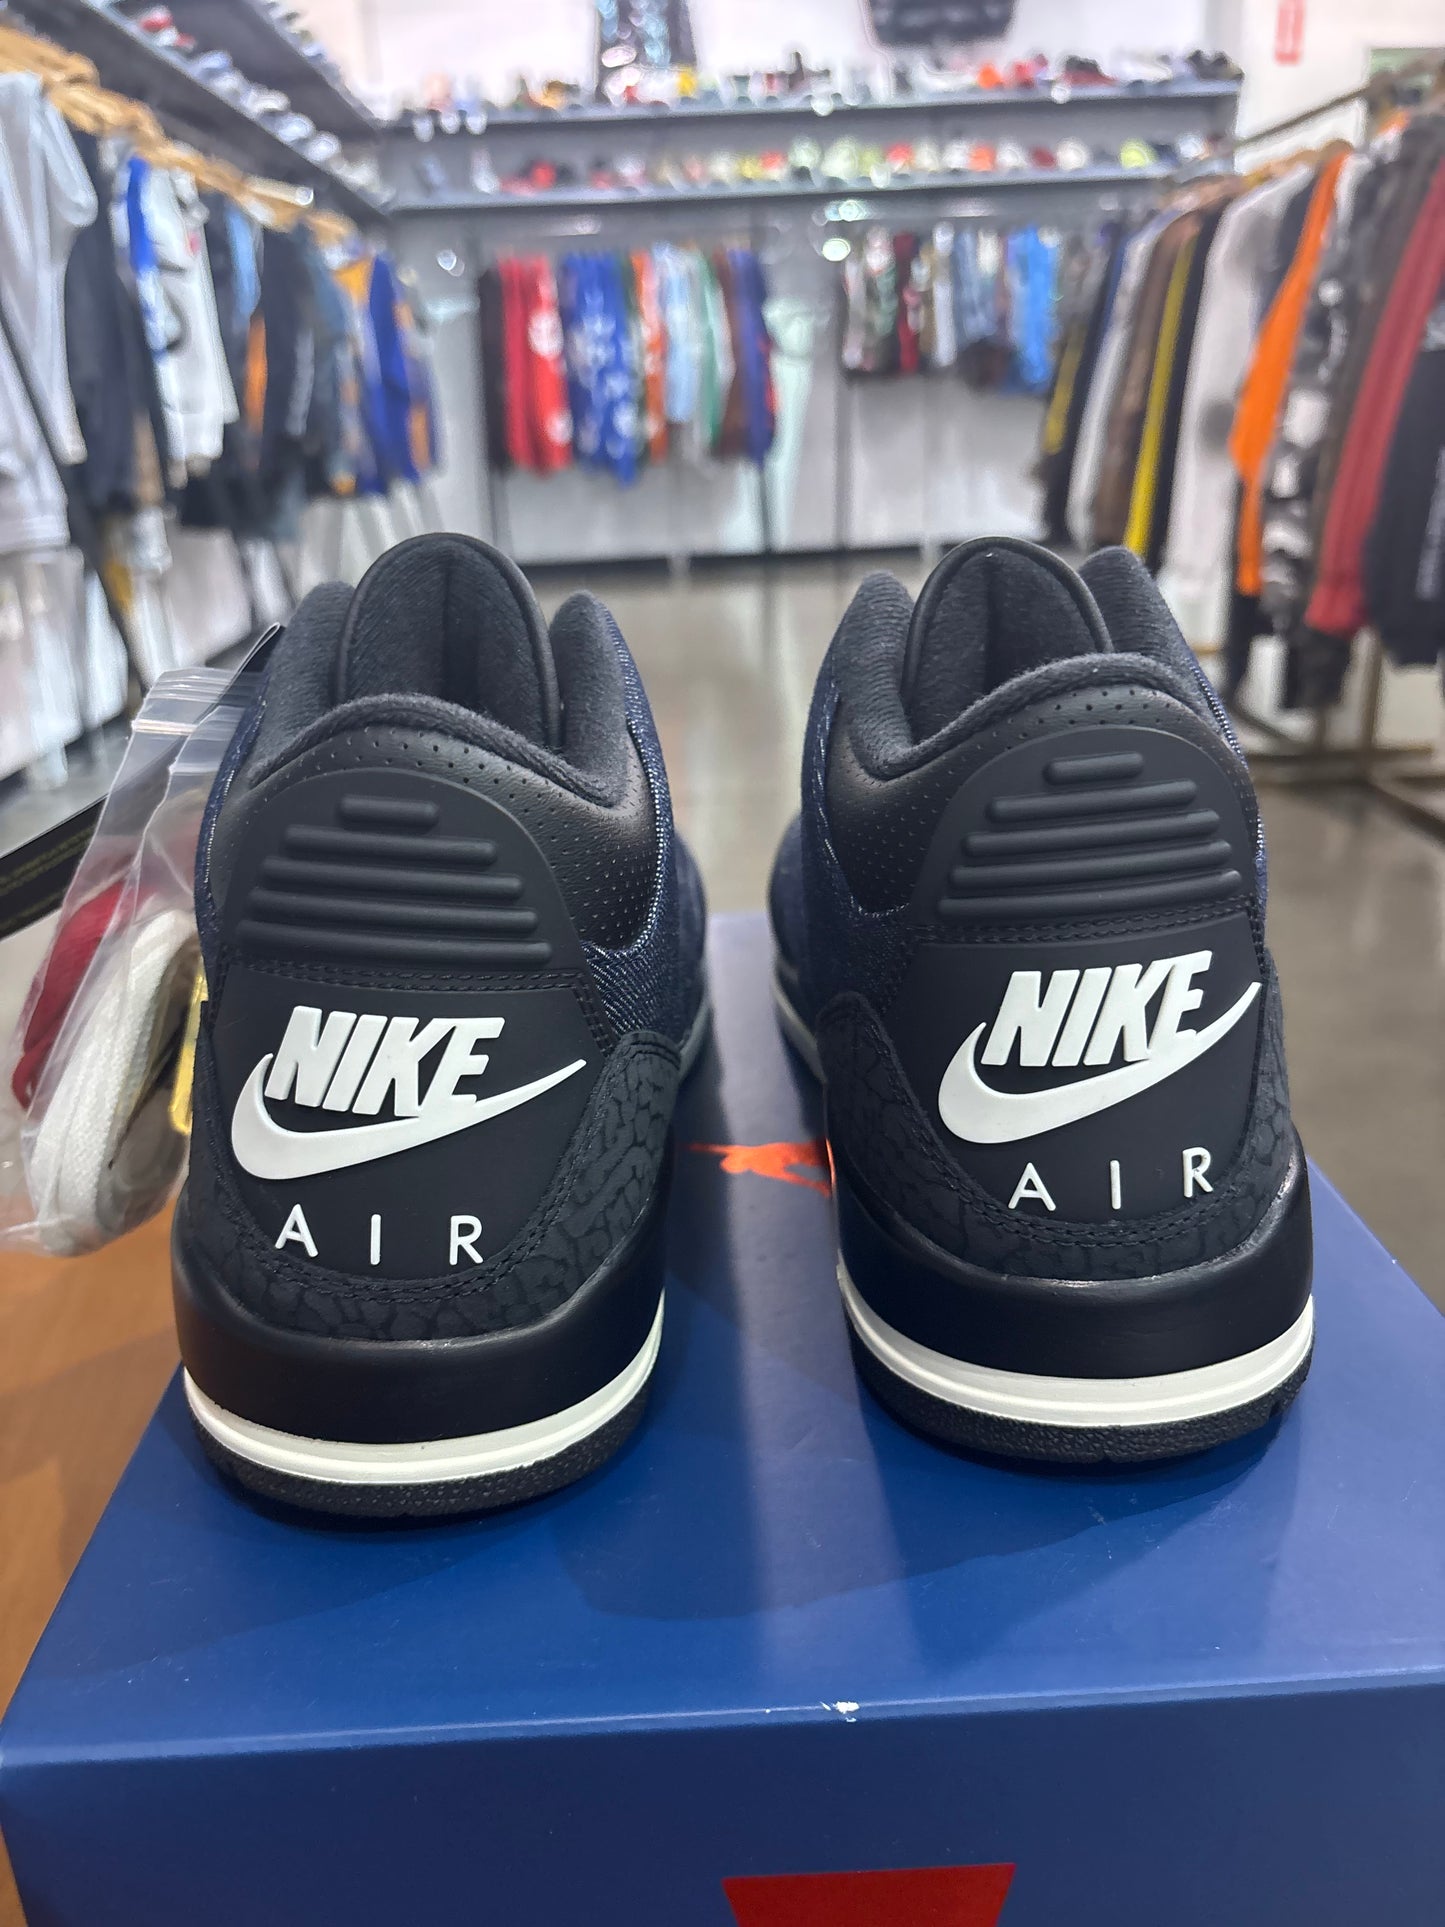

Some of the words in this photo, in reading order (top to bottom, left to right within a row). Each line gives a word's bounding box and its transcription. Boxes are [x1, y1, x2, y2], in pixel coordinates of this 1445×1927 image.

[981, 950, 1213, 1067] NIKE
[265, 1005, 505, 1118] NIKE
[1008, 1147, 1214, 1211] AIR
[274, 1203, 484, 1266] AIR
